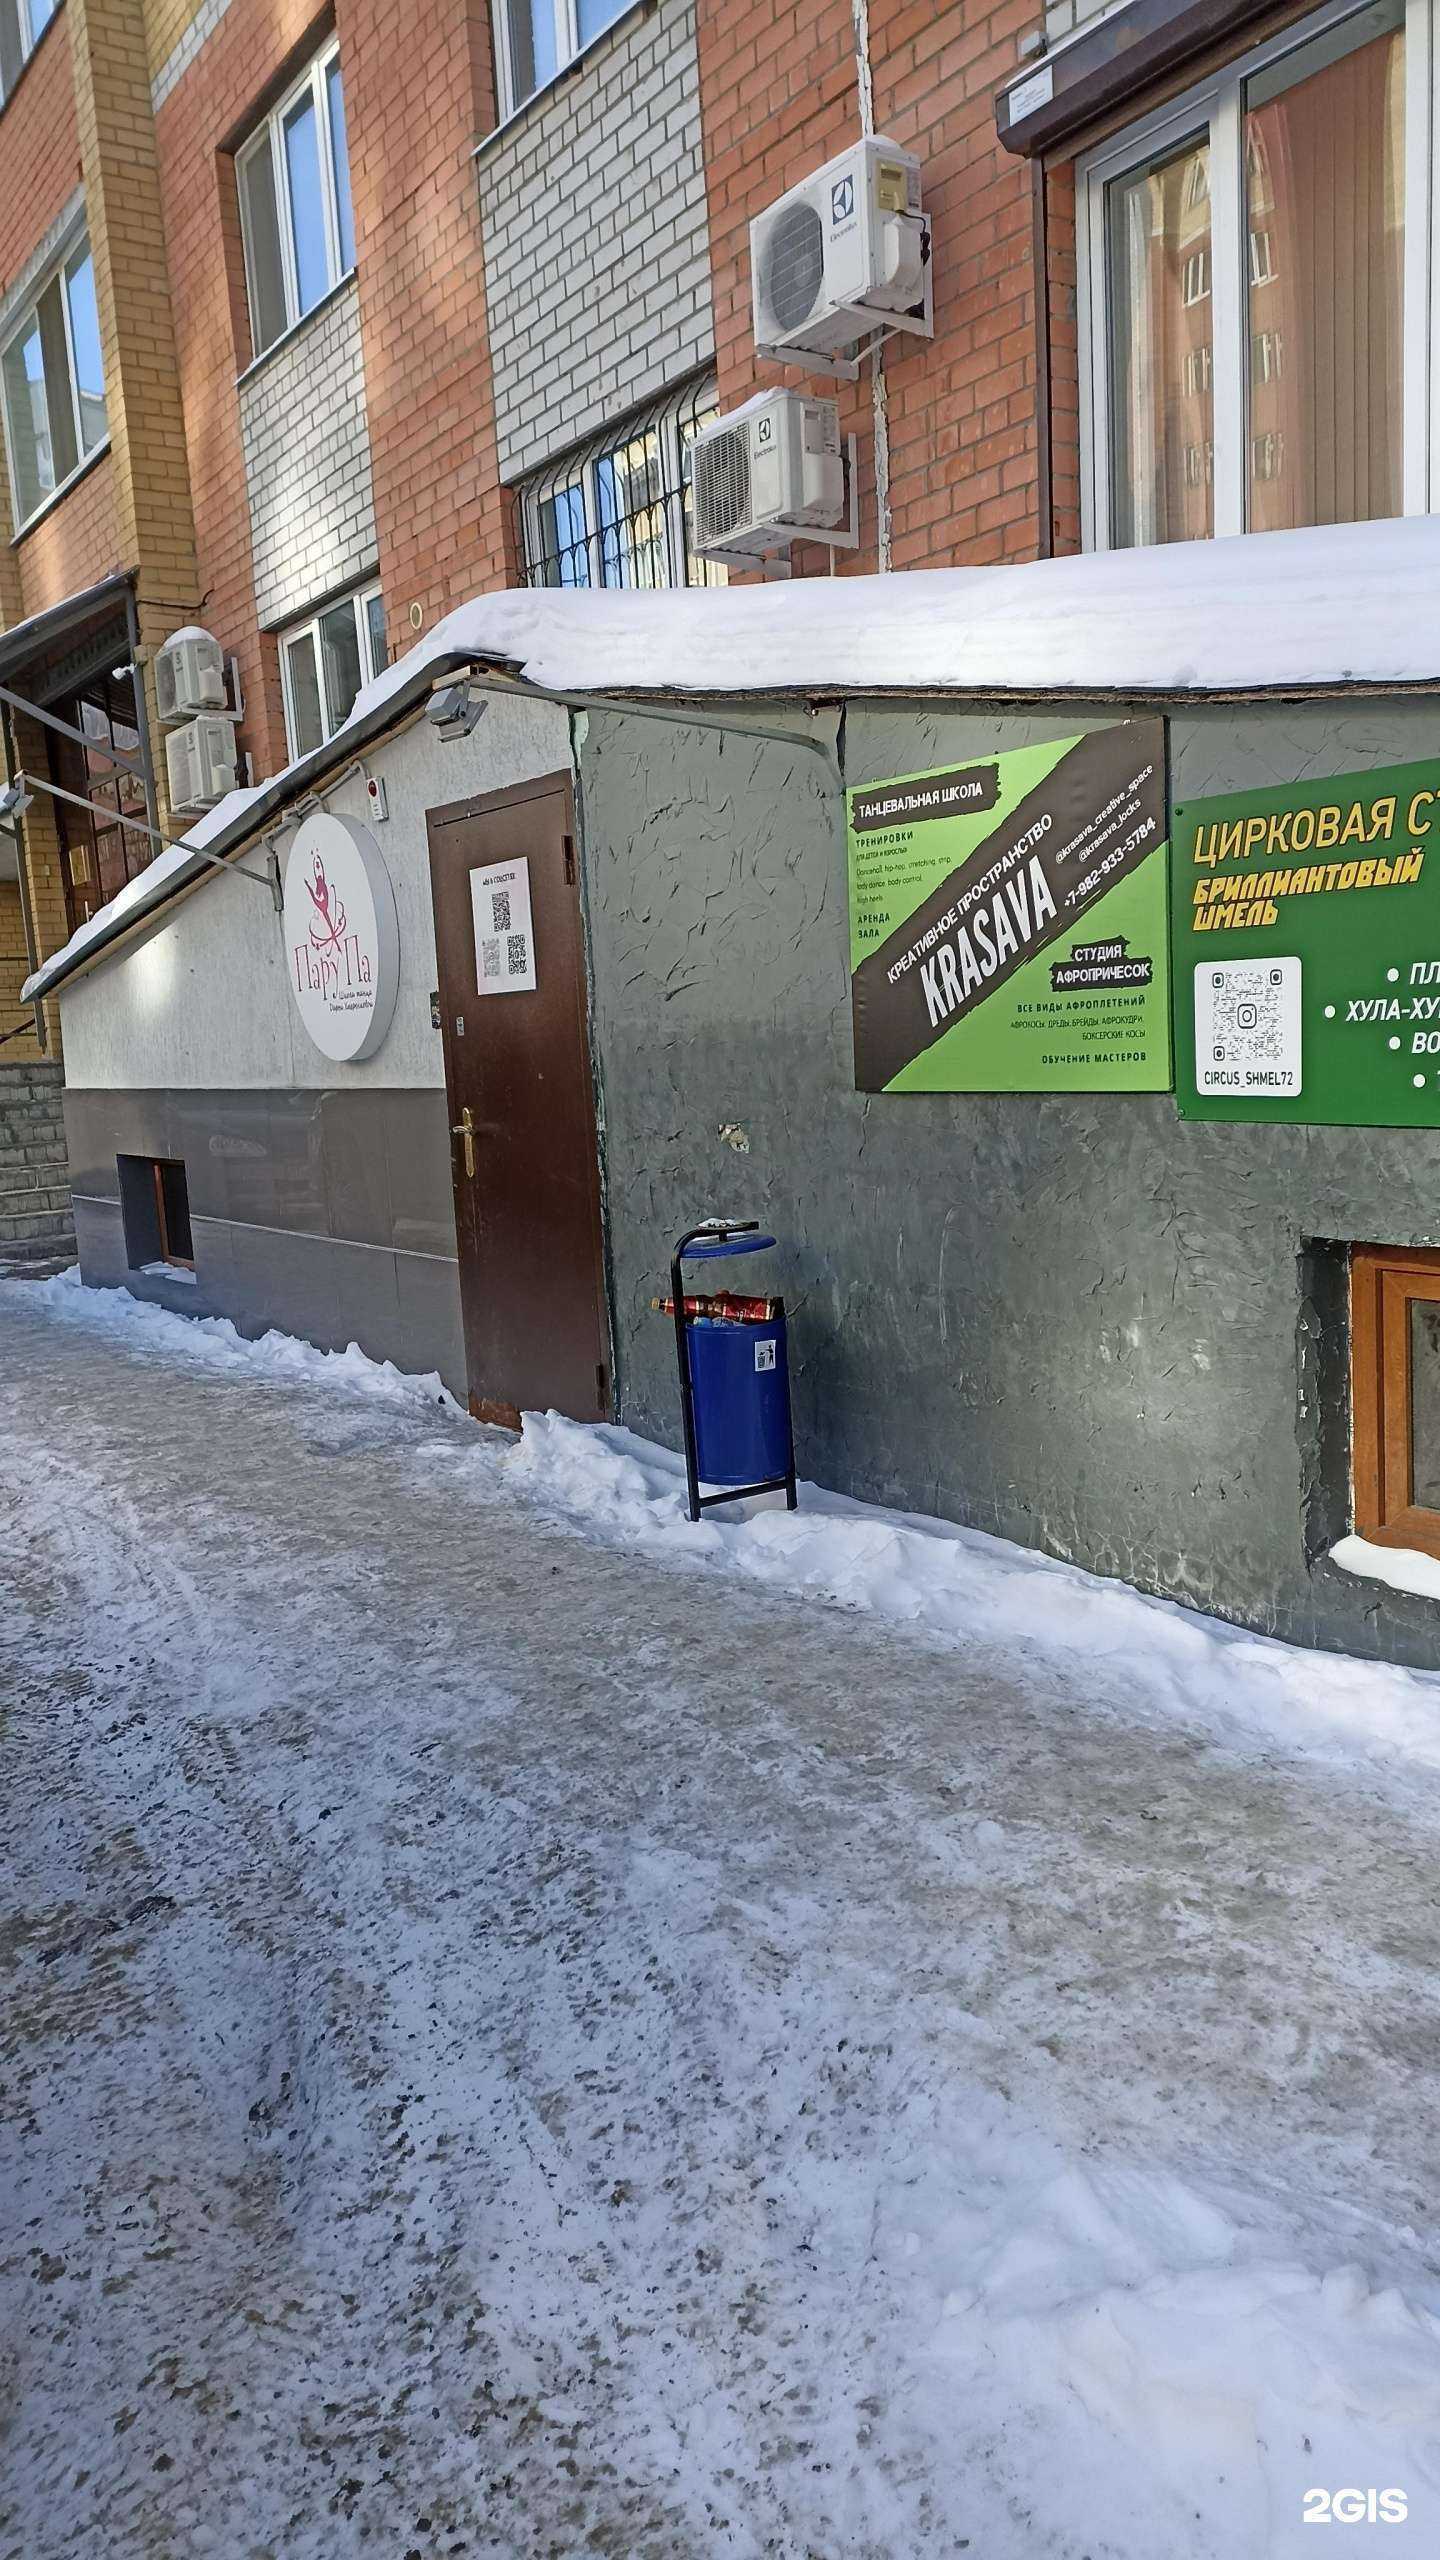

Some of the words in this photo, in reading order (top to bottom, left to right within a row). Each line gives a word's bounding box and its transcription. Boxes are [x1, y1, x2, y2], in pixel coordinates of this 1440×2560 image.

[859, 790, 940, 818] ТАНЦЕВАЛЬНАЯ
[941, 782, 983, 802] ШКОЛА
[1055, 765, 1153, 865] @krasava_creative_space
[856, 831, 914, 848] ТРЕНИРОВКИ
[1078, 798, 1142, 863] @krasava_locks
[1193, 796, 1397, 869] ЦИРКОВАЯ
[1064, 816, 1156, 907] +7-982-933-5784
[1192, 847, 1425, 905] БРИЛЛИАНТОВЫЙ
[887, 907, 958, 984] КРЕАТИВНОЕ
[956, 814, 1052, 916] ПРОСТРАНСТВО
[858, 913, 890, 924] АРЕНДА
[1192, 899, 1279, 931] ШМЕЛЬ
[858, 929, 880, 939] ЗАЛА
[920, 855, 1057, 1028] KRASAVA
[1074, 944, 1122, 962] СТУДИЯ
[1056, 963, 1150, 984] АФРОПРИЧЕСОК
[1017, 1004, 1033, 1013] ВСЕ
[1036, 1002, 1063, 1013] ВИДЫ
[1066, 994, 1146, 1010] АФРОПЛЕТЕНИЙ
[1345, 997, 1440, 1021] ХУЛА-ХУ
[1082, 1031, 1124, 1040] БОКСЕРСКИЕ
[1125, 1030, 1146, 1038] КОСЫ
[1042, 1054, 1091, 1064] ОБУЧЕНИЕ
[1094, 1052, 1147, 1063] МАСТЕРОВ
[1204, 1071, 1293, 1088] CIRCUS_SHMEL72
